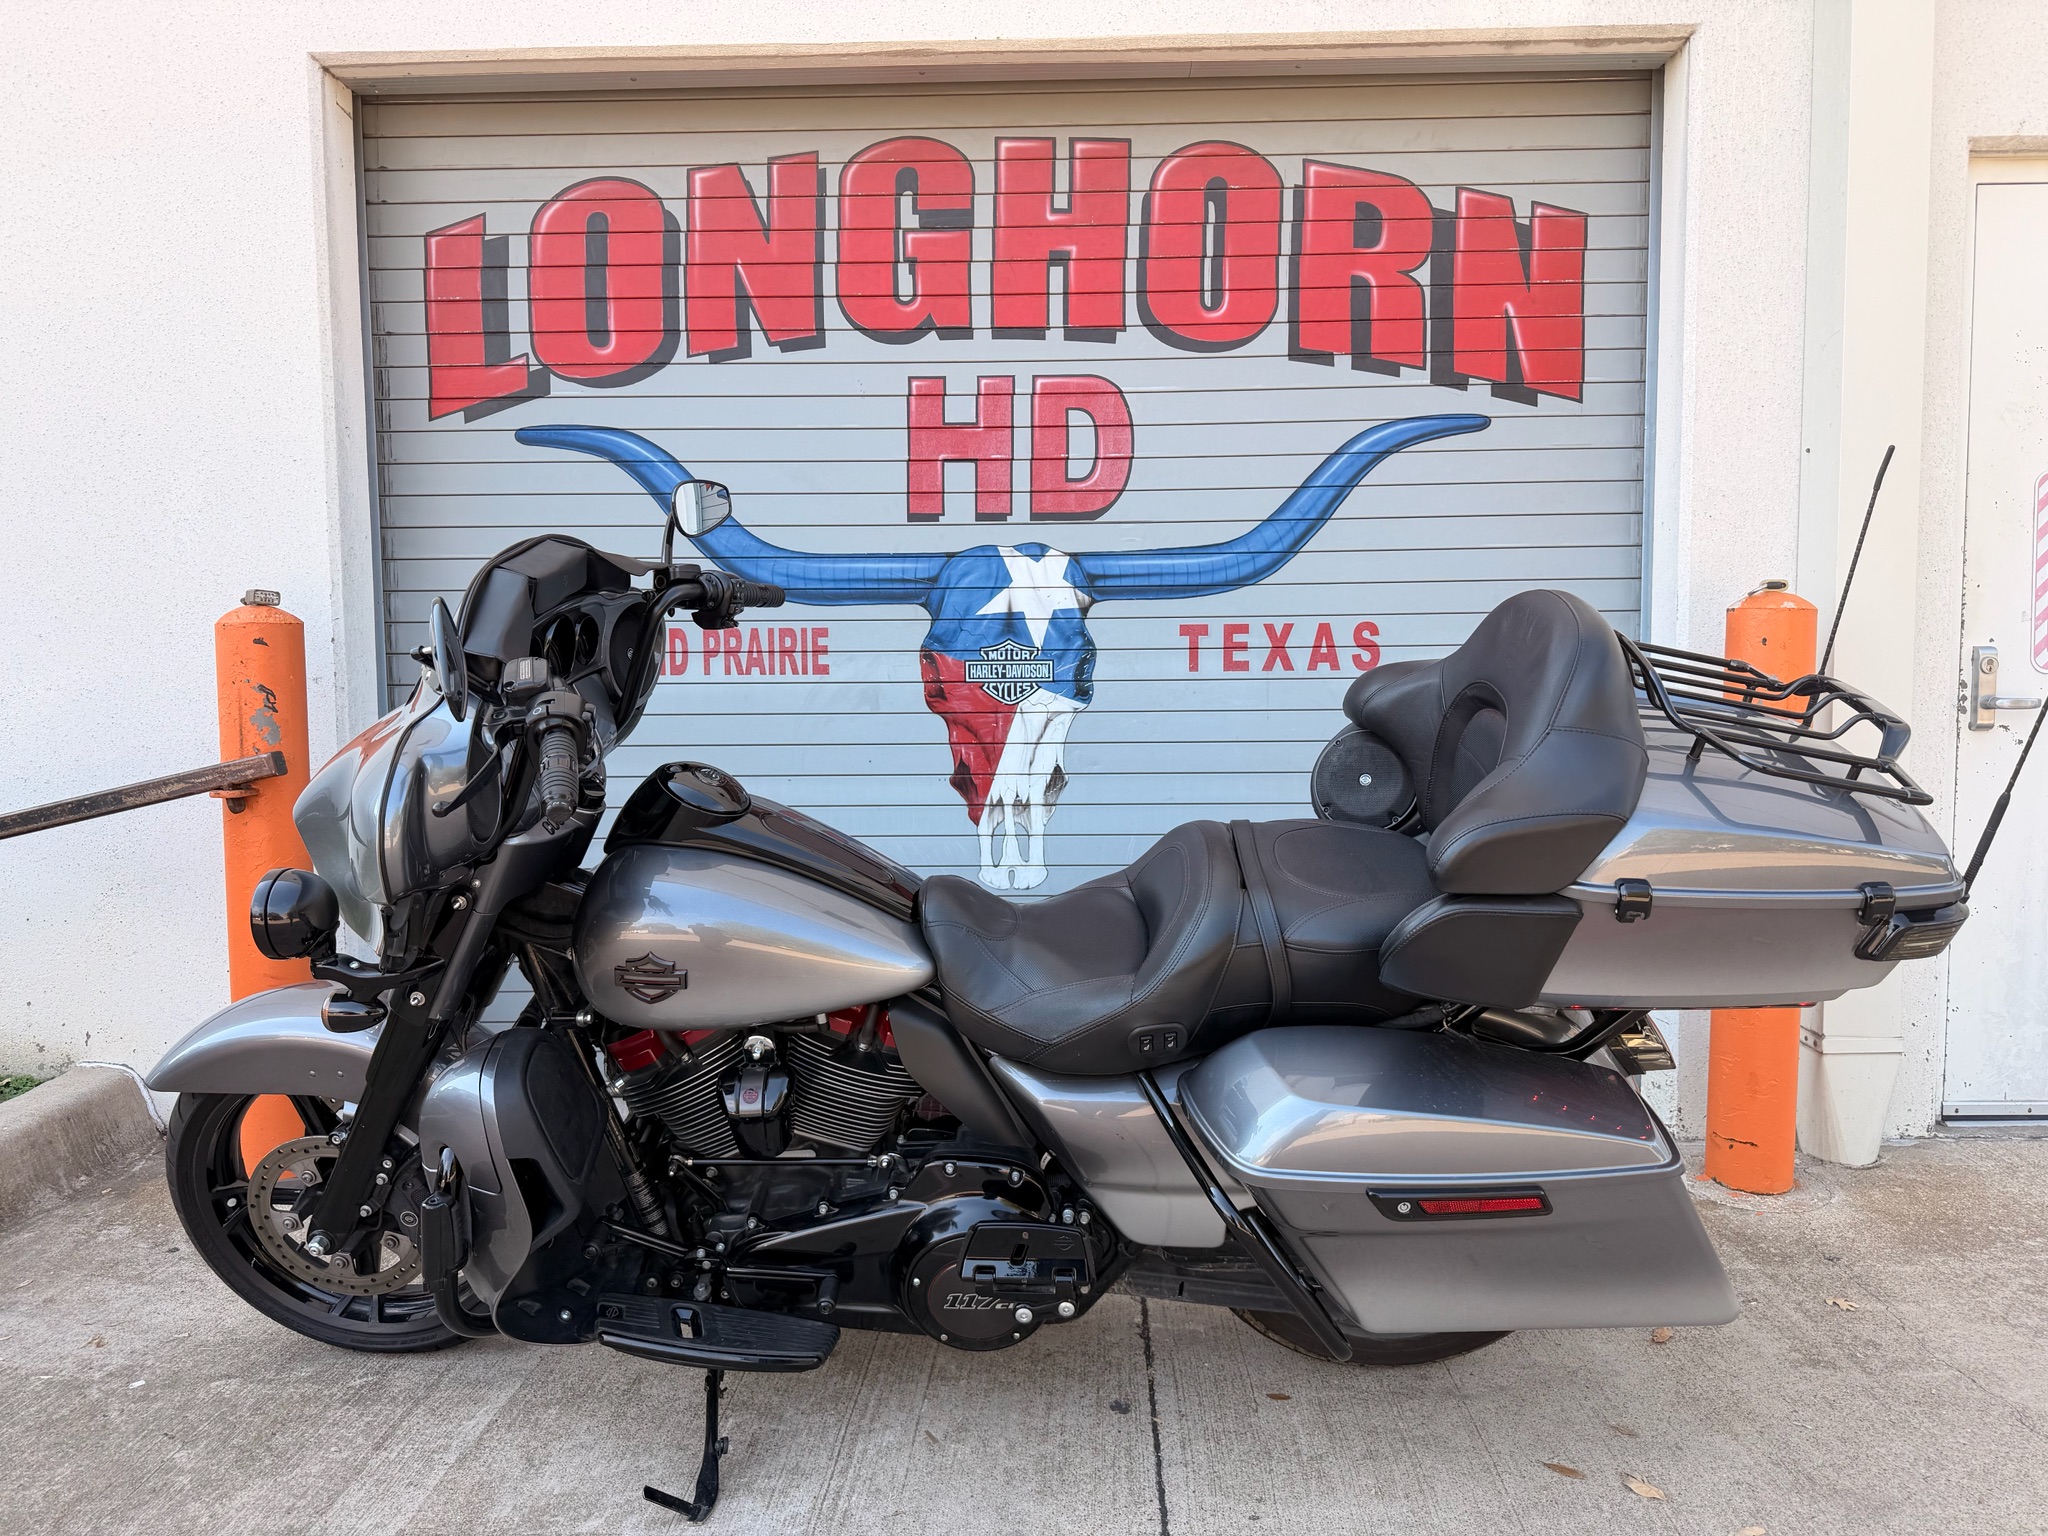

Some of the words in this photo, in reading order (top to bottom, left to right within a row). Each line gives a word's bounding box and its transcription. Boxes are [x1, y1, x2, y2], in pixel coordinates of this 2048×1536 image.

[424, 136, 1589, 425] LONGHORN
[907, 373, 1134, 522] HD
[702, 627, 830, 676] PRAIRIE
[969, 663, 1049, 679] HARLEY-DAVIDSON
[988, 643, 1031, 661] MOTOR
[1178, 621, 1382, 673] TEXAS
[989, 682, 1031, 701] CYCLES
